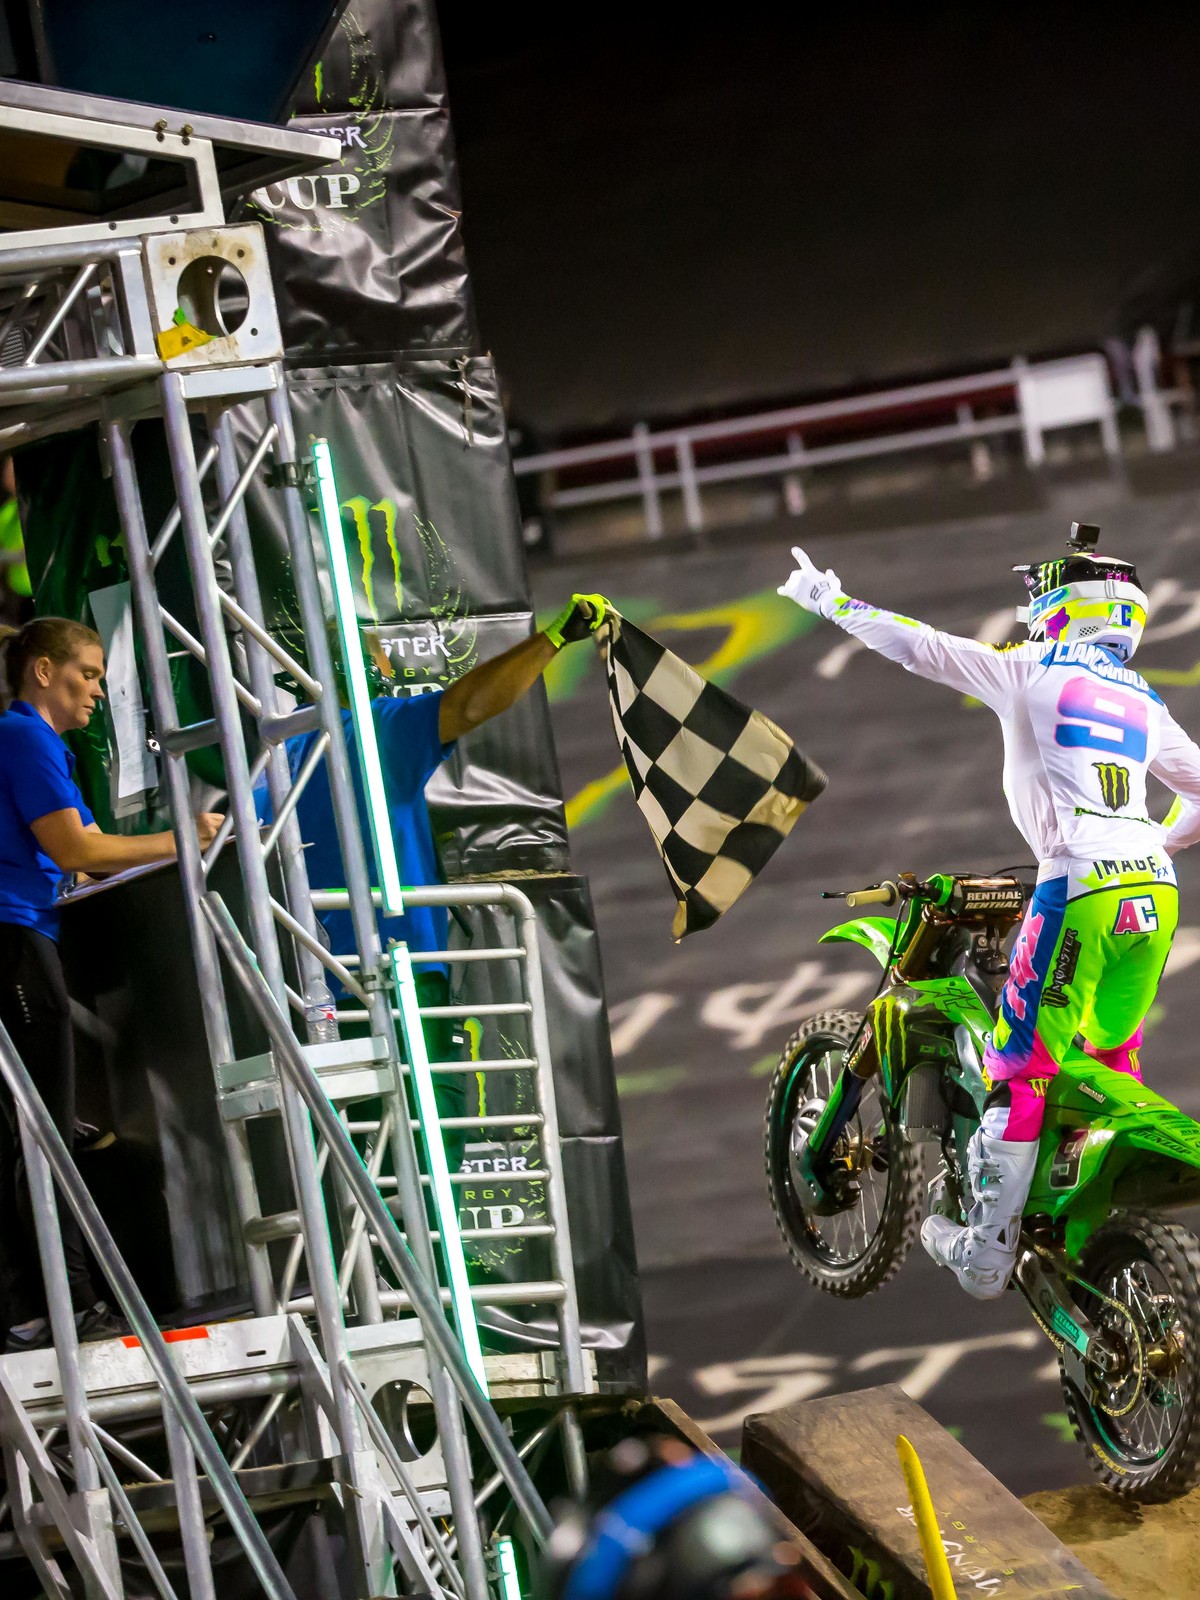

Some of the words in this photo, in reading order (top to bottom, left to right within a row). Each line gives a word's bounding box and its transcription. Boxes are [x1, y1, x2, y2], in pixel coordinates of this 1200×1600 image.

[255, 173, 361, 210] CUP
[1106, 603, 1132, 628] AC
[1055, 676, 1149, 764] 9
[1092, 855, 1157, 880] IMAGE
[1156, 865, 1170, 880] FX
[964, 901, 1019, 910] RENTHAL
[966, 891, 1022, 901] RENTHAL
[1112, 895, 1159, 935] AC
[1052, 928, 1079, 992] MONSTER
